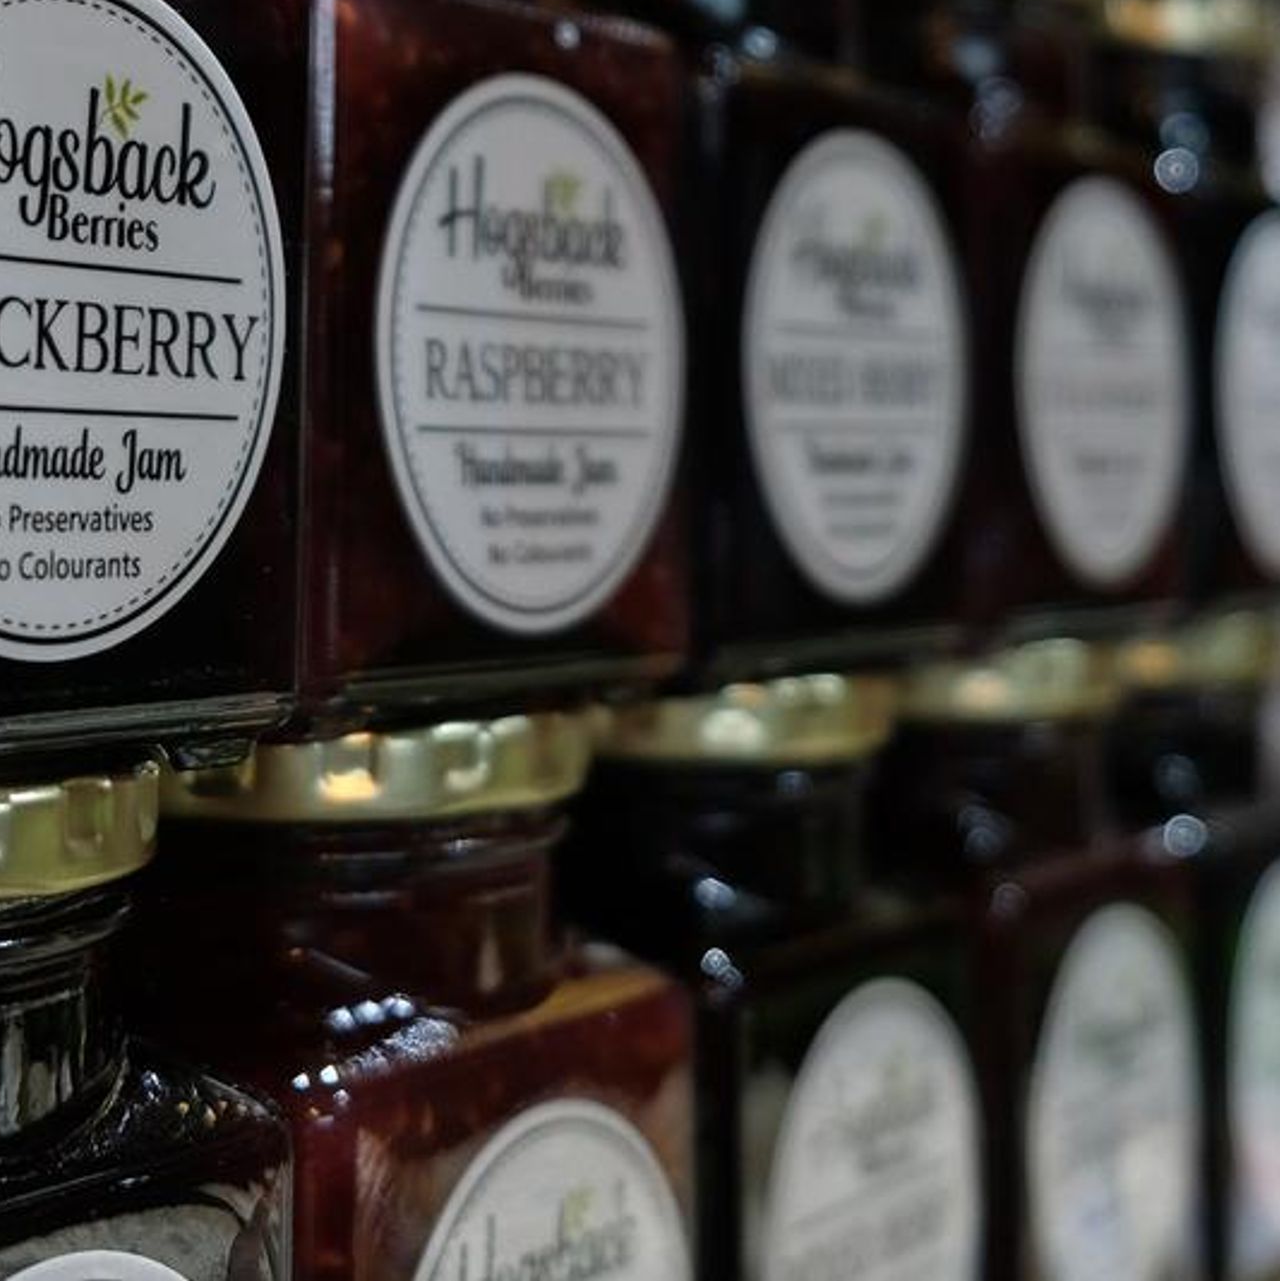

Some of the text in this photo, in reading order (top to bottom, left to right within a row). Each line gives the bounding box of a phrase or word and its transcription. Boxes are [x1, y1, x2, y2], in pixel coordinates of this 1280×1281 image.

[46, 195, 160, 253] Berries
[424, 335, 650, 410] RASPBERRY
[115, 428, 187, 494] Jam
[8, 504, 154, 536] Preservatives
[18, 551, 142, 582] Colourants
